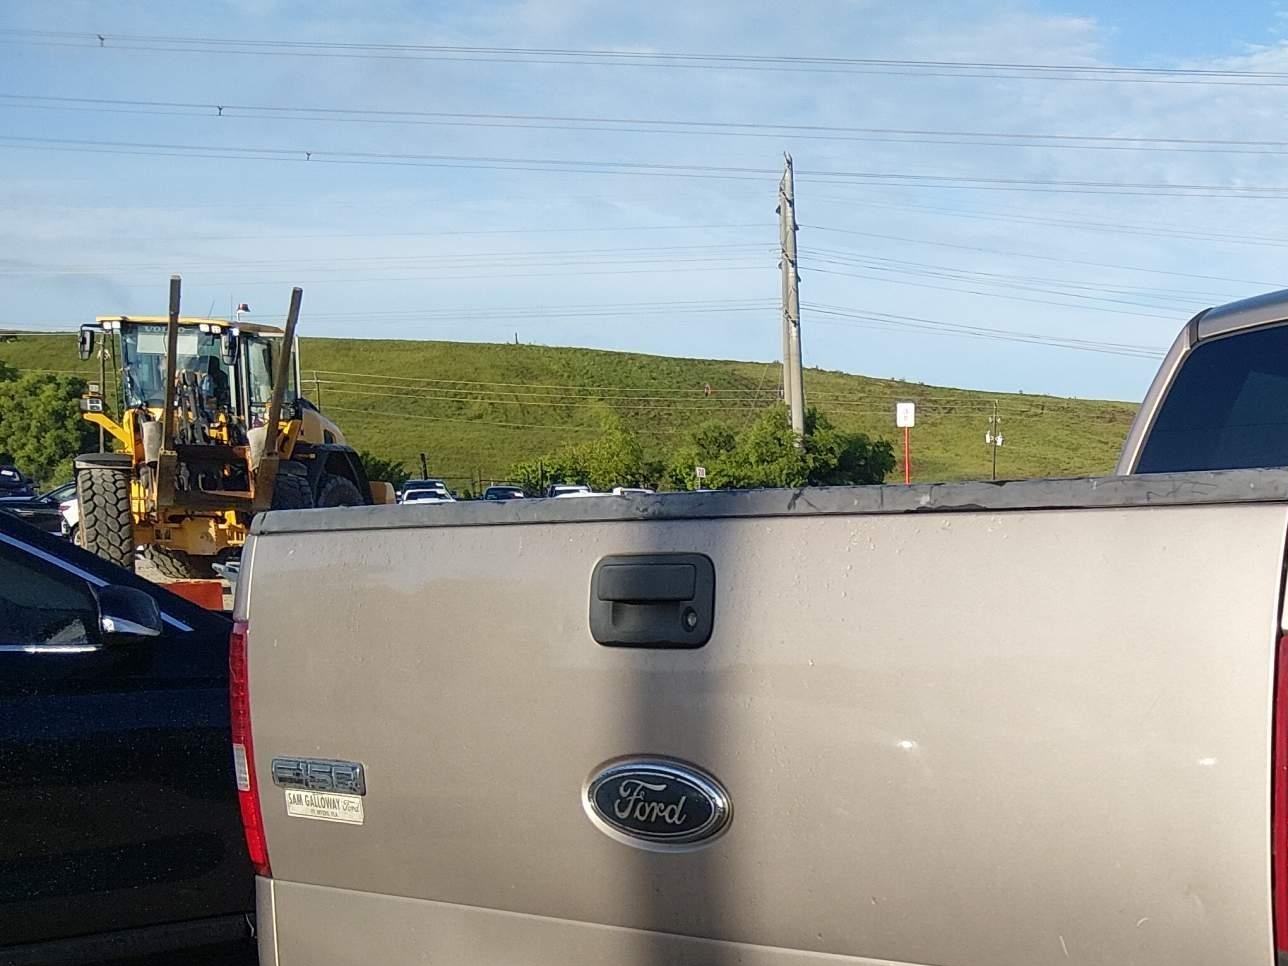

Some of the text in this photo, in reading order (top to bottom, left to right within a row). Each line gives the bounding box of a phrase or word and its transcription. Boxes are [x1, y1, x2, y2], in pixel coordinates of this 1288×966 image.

[288, 793, 304, 806] SAM
[304, 794, 341, 810] GALLOWAY
[342, 799, 360, 813] Ford
[614, 779, 687, 825] Ford
